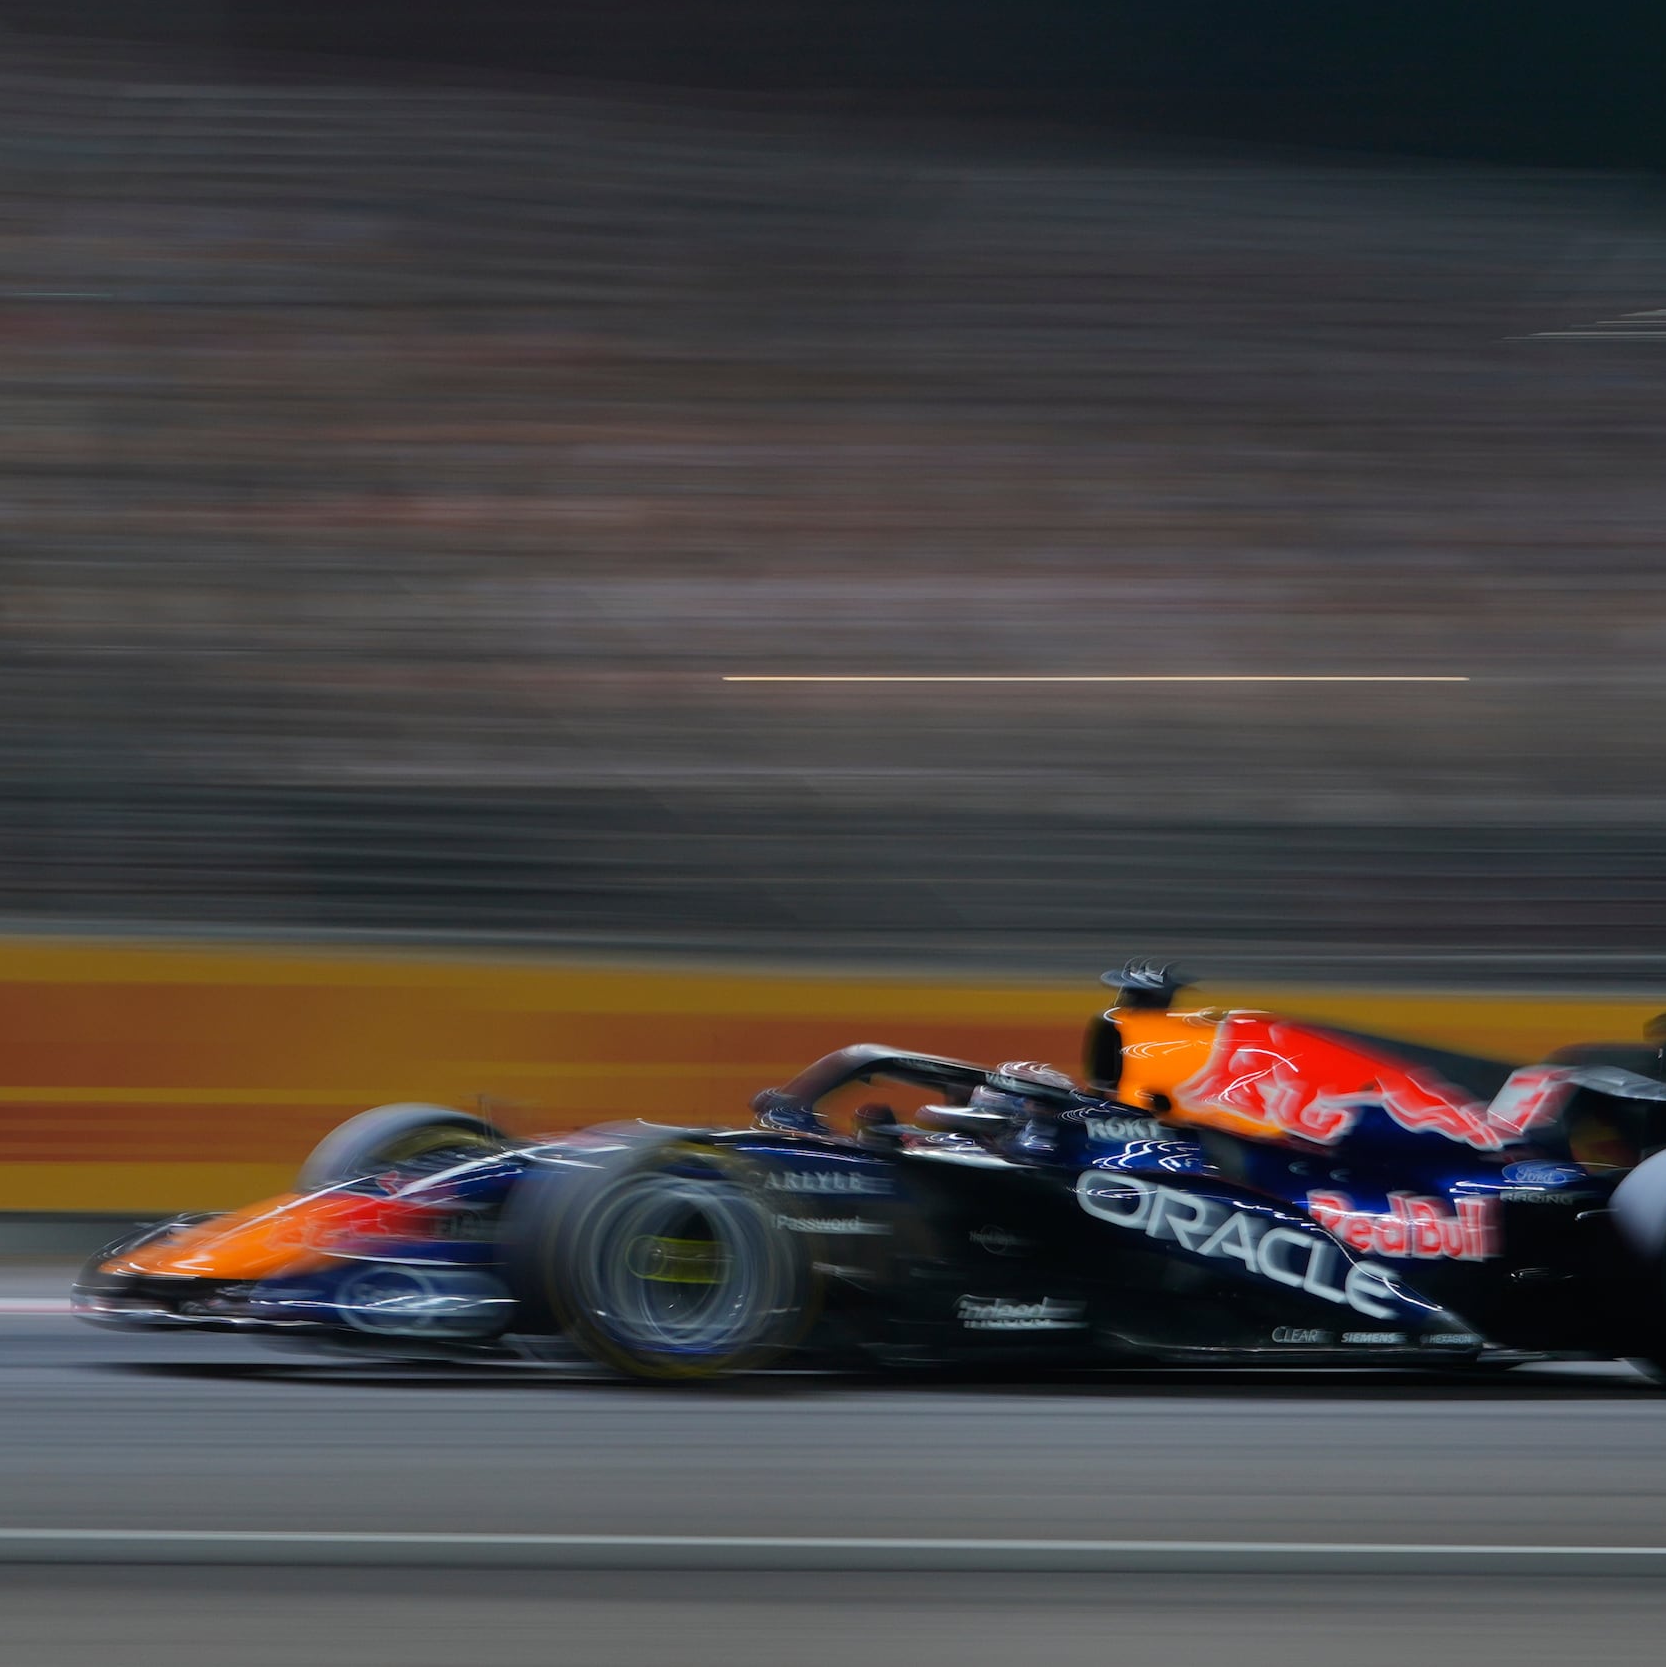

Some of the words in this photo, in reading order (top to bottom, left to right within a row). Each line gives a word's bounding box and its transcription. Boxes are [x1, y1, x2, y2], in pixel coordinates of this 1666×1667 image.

[1515, 1164, 1554, 1183] Ford
[1307, 1189, 1409, 1259] Red
[1405, 1194, 1491, 1263] Bull
[1076, 1169, 1400, 1321] ORACLE
[1271, 1326, 1319, 1344] CLEAR
[1340, 1332, 1398, 1344] SIEMENS
